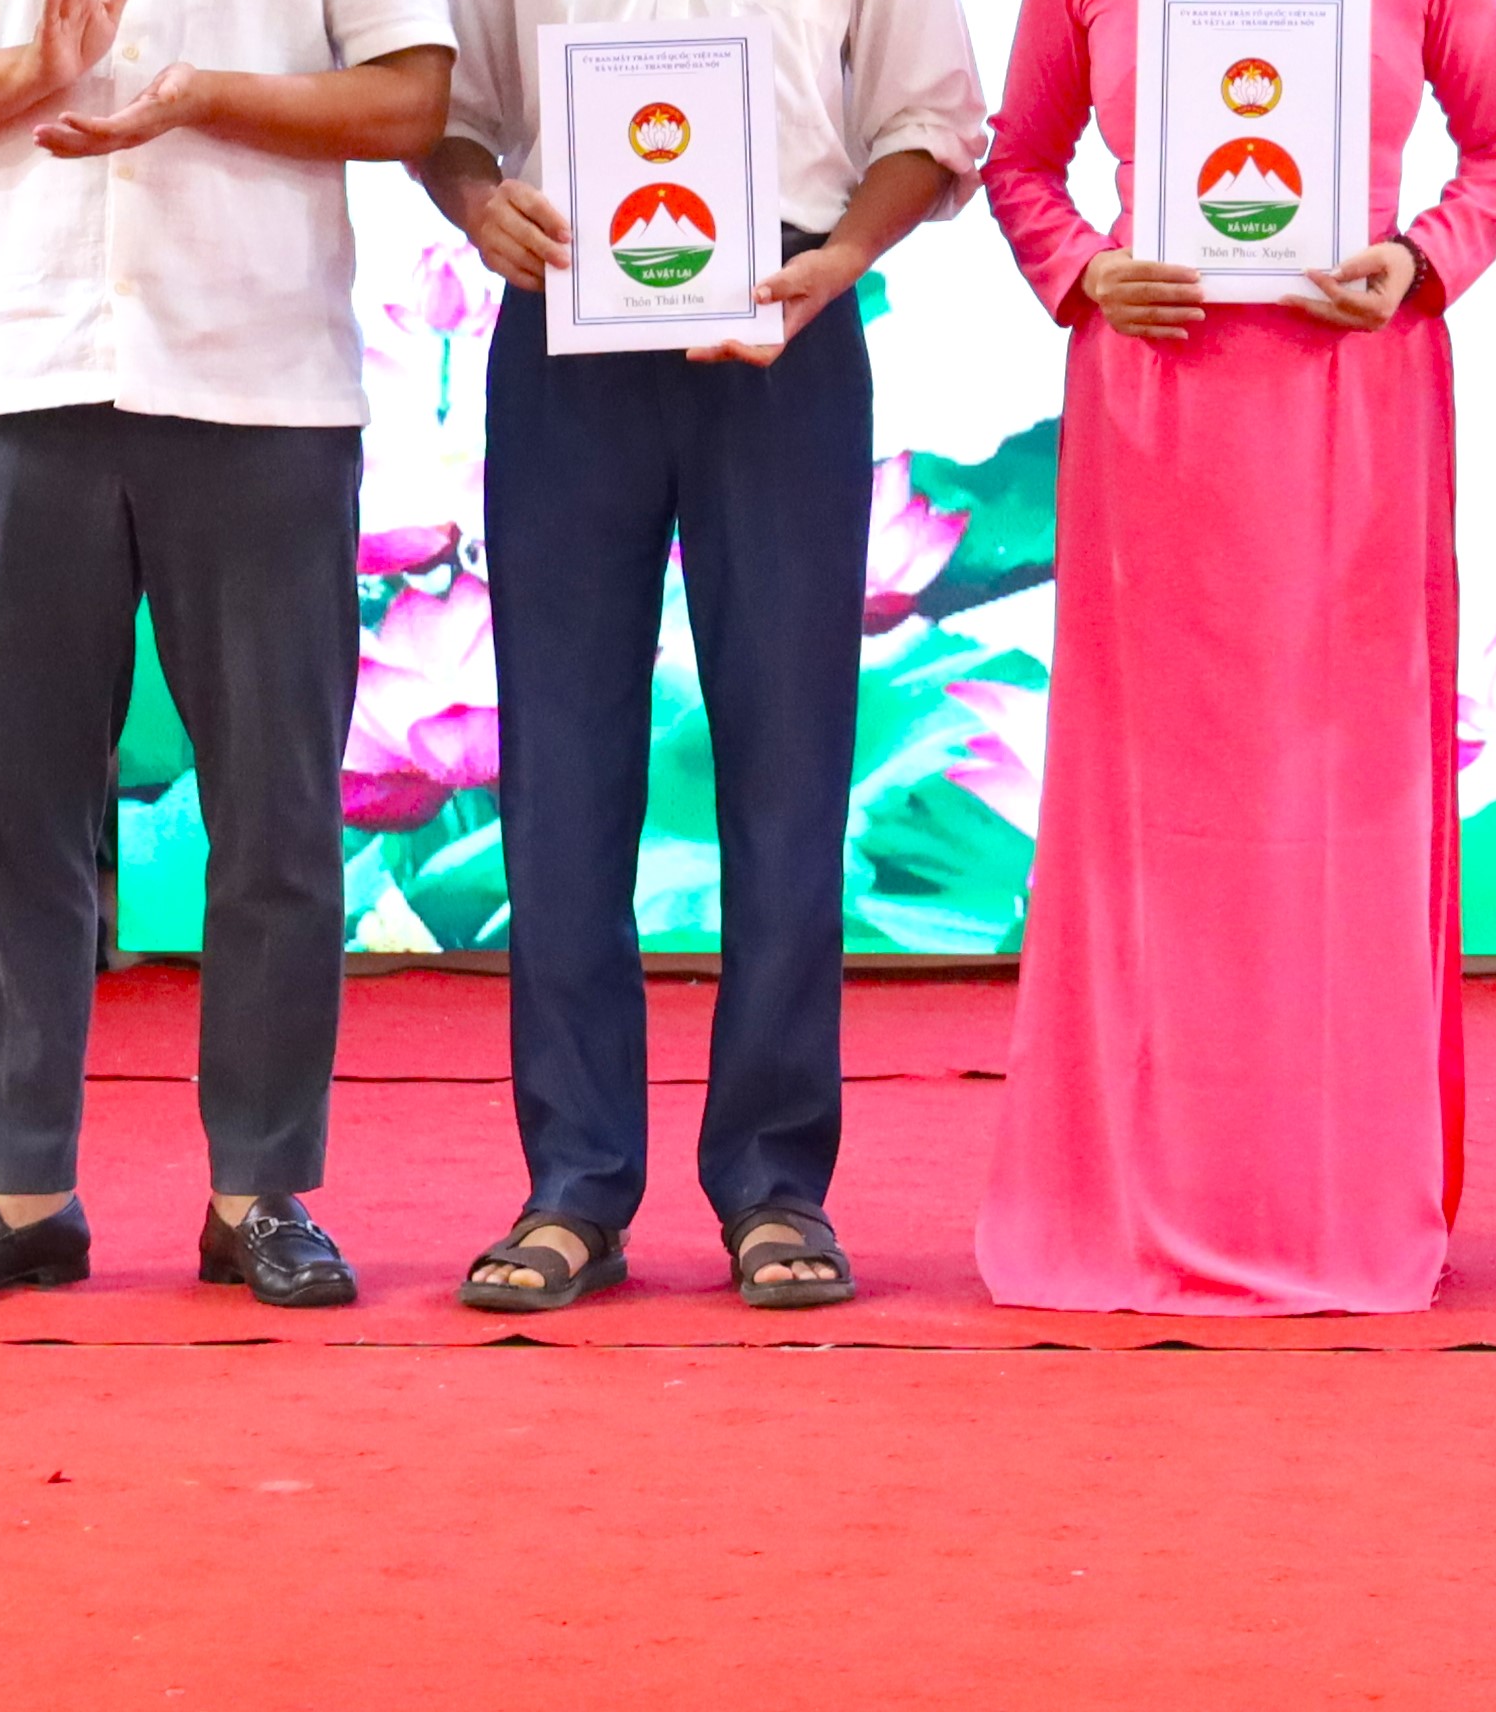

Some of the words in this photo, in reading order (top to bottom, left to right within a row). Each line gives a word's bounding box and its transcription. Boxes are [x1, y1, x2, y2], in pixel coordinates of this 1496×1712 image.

[1227, 220, 1241, 233] XÃ
[1261, 222, 1277, 235] LẠI
[642, 268, 655, 280] XÃ
[676, 268, 692, 280] LẠI
